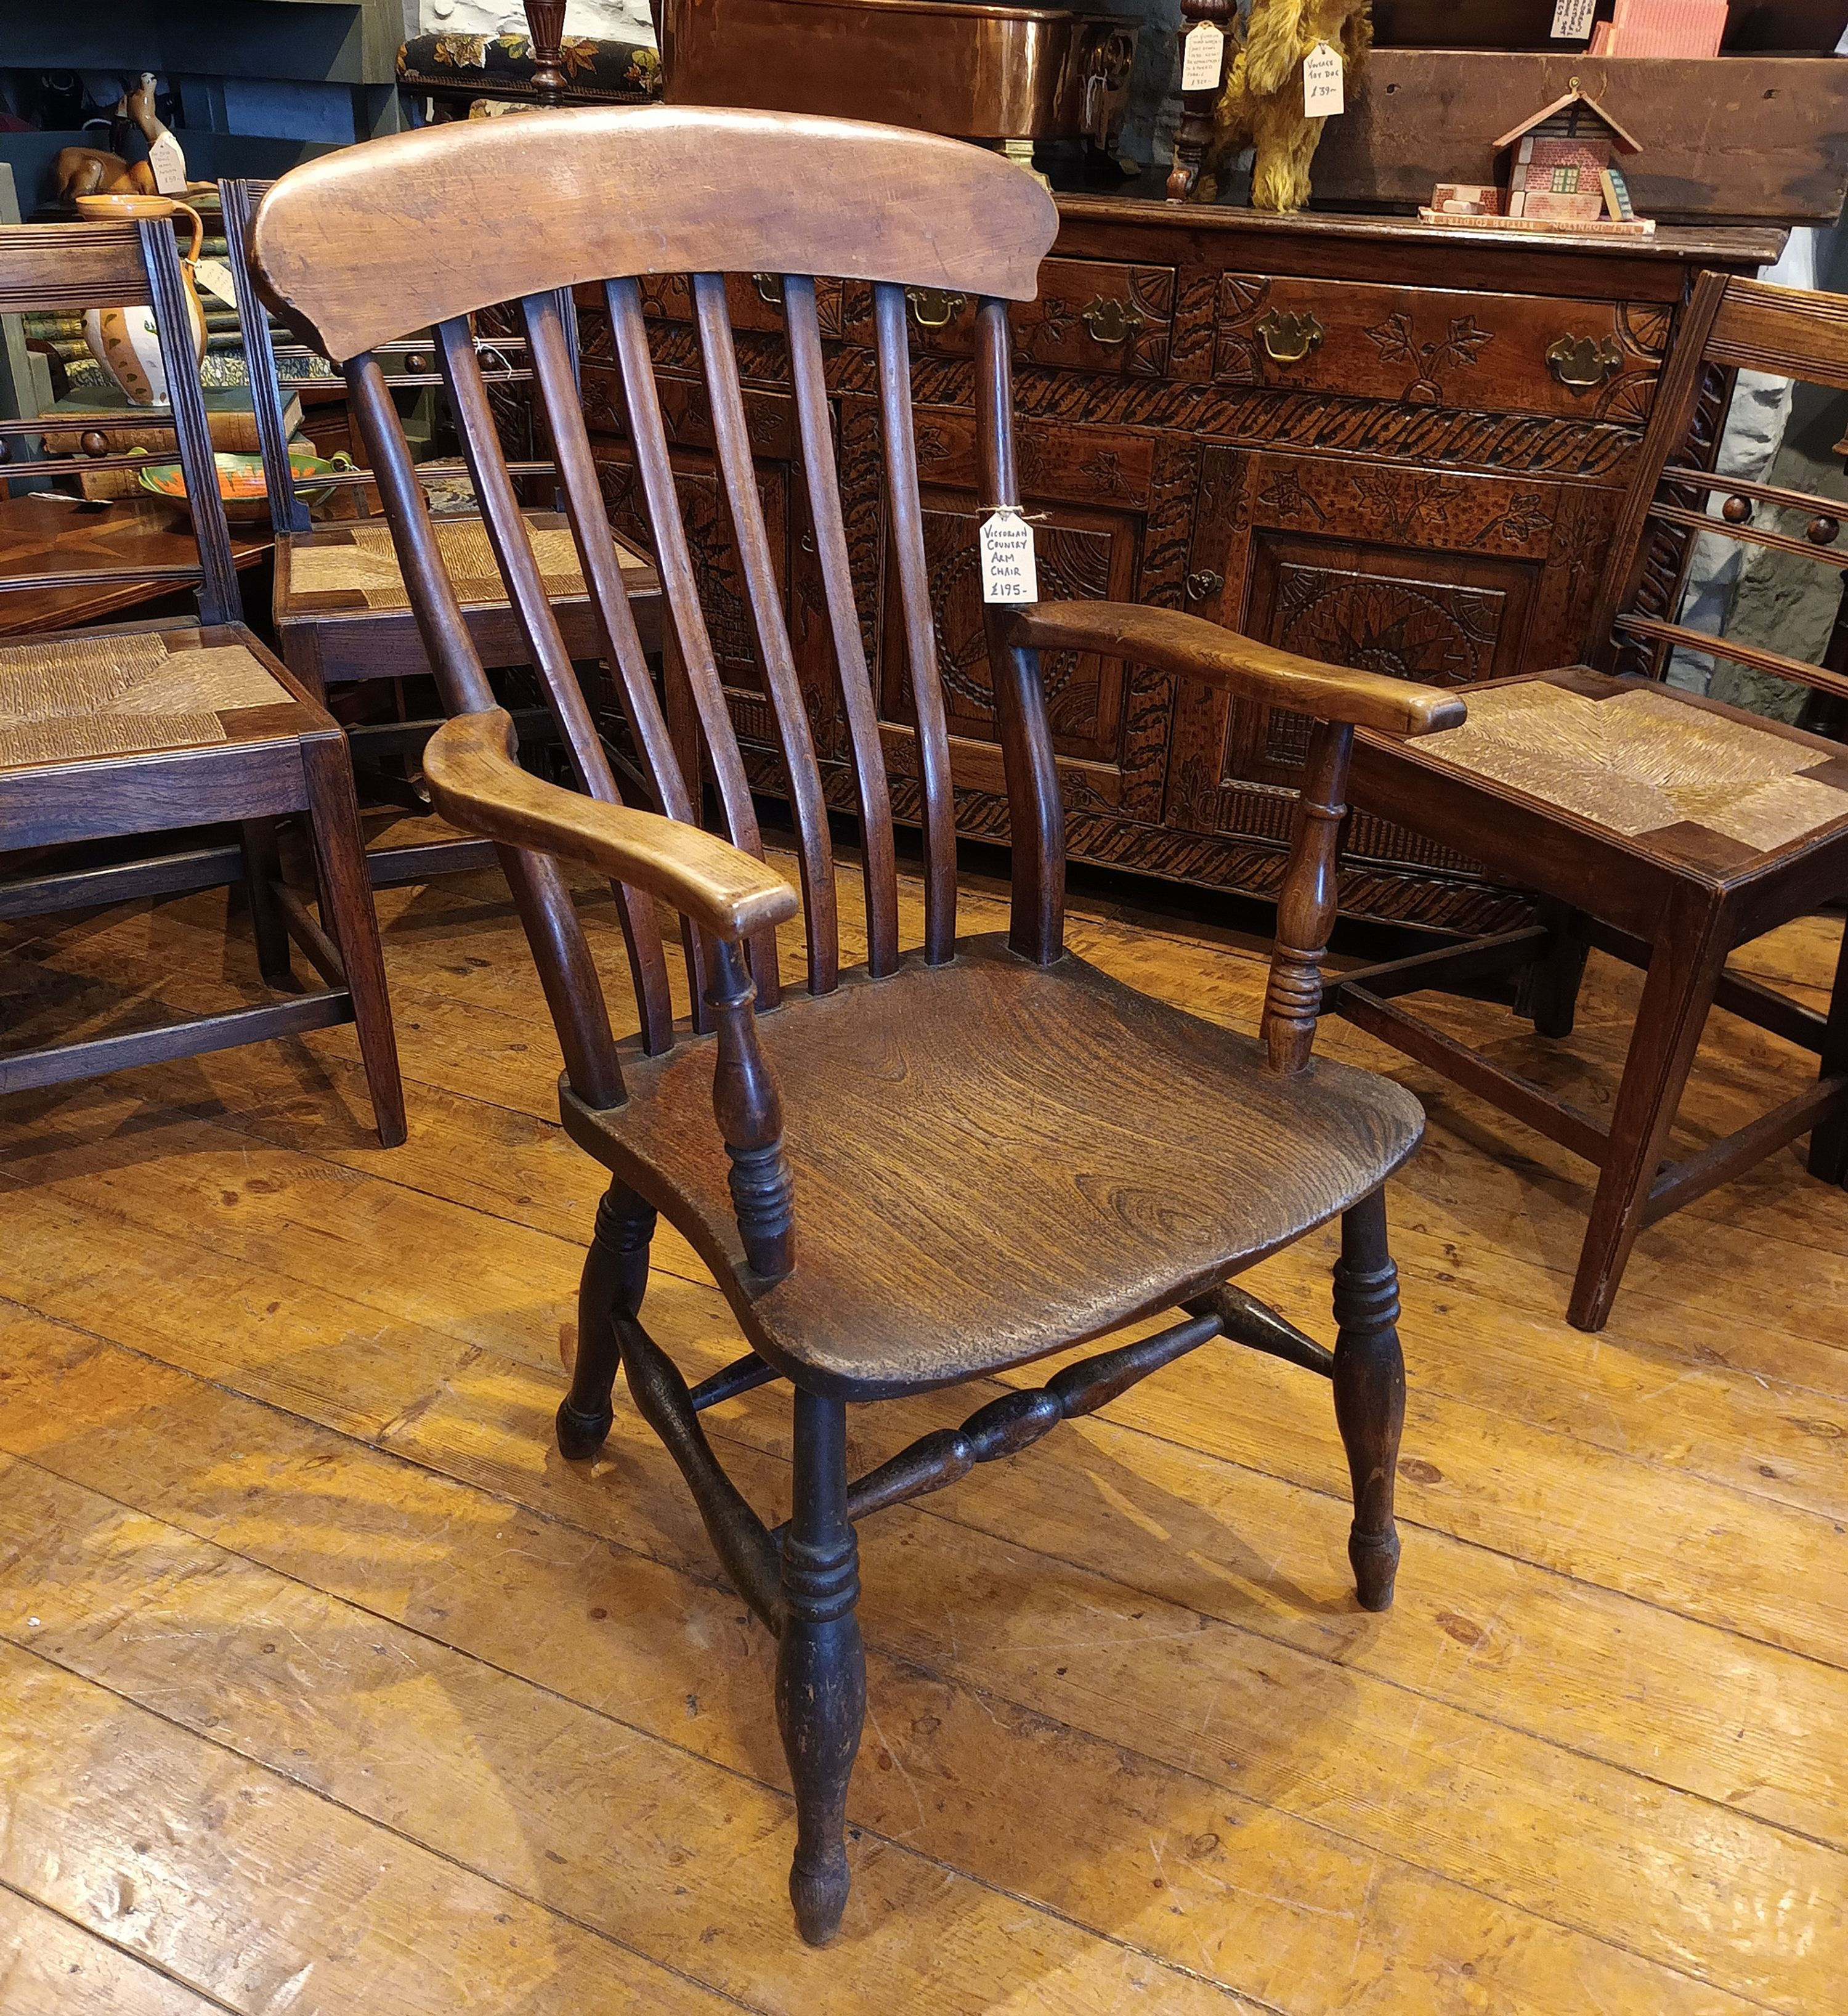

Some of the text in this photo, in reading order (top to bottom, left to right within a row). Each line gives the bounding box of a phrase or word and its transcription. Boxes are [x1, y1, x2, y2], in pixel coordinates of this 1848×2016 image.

[1308, 70, 1339, 79] TOY DOG
[1442, 217, 1534, 229] BRITISH SOLDIERS
[984, 524, 1027, 539] VICTORIAN
[987, 540, 1027, 550] COUNTRY
[991, 552, 1015, 563] ARM
[991, 566, 1021, 576] CHAIR
